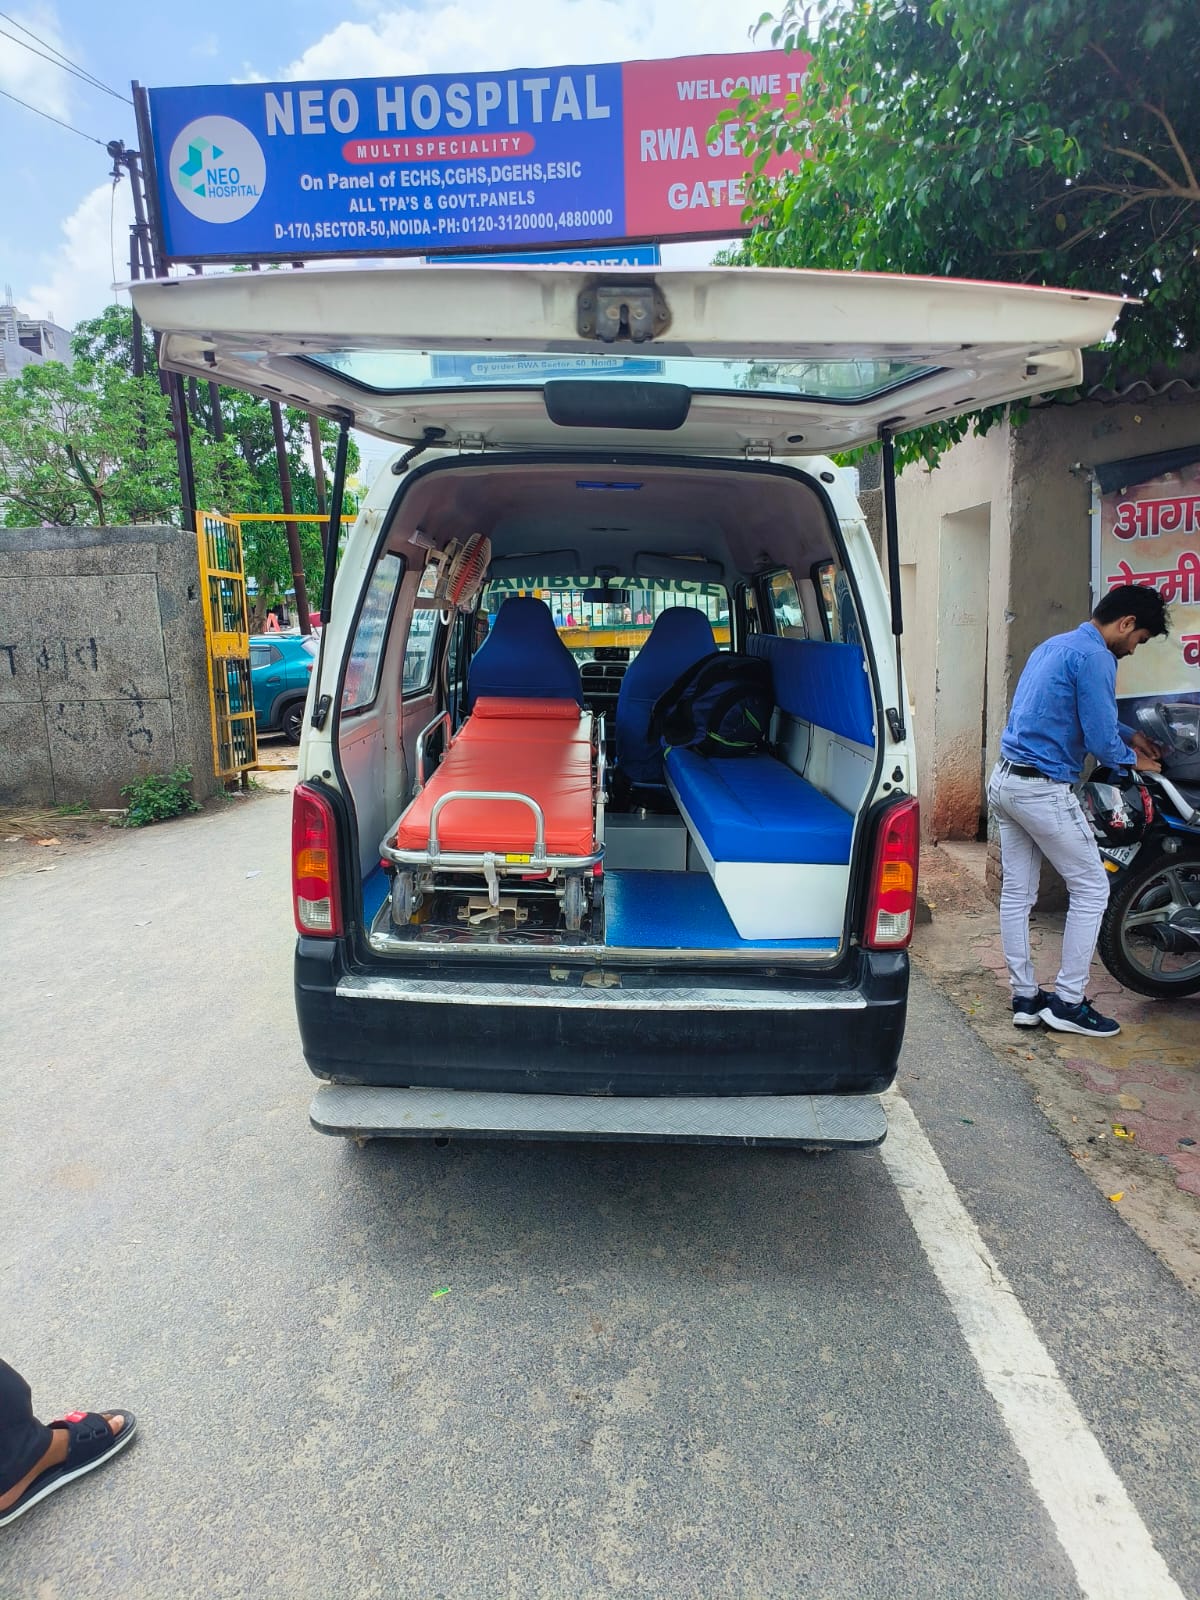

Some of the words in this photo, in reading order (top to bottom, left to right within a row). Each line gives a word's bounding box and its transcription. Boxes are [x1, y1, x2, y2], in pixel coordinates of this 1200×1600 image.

[676, 73, 781, 101] WELCOME
[264, 88, 360, 136] NEO
[376, 74, 611, 132] HOSPITAL
[356, 143, 409, 159] MULTI
[415, 137, 521, 157] SPECIALITY
[640, 126, 700, 162] RWA
[206, 167, 241, 186] NEO
[300, 174, 324, 191] On
[327, 171, 375, 190] Panel
[379, 171, 396, 188] of
[208, 184, 261, 199] HOSPITAL
[349, 197, 376, 213] ALL
[379, 195, 419, 211] TPA'S
[423, 195, 434, 210] &
[437, 190, 536, 210] GOVT.PANELS
[667, 177, 746, 211] GATE
